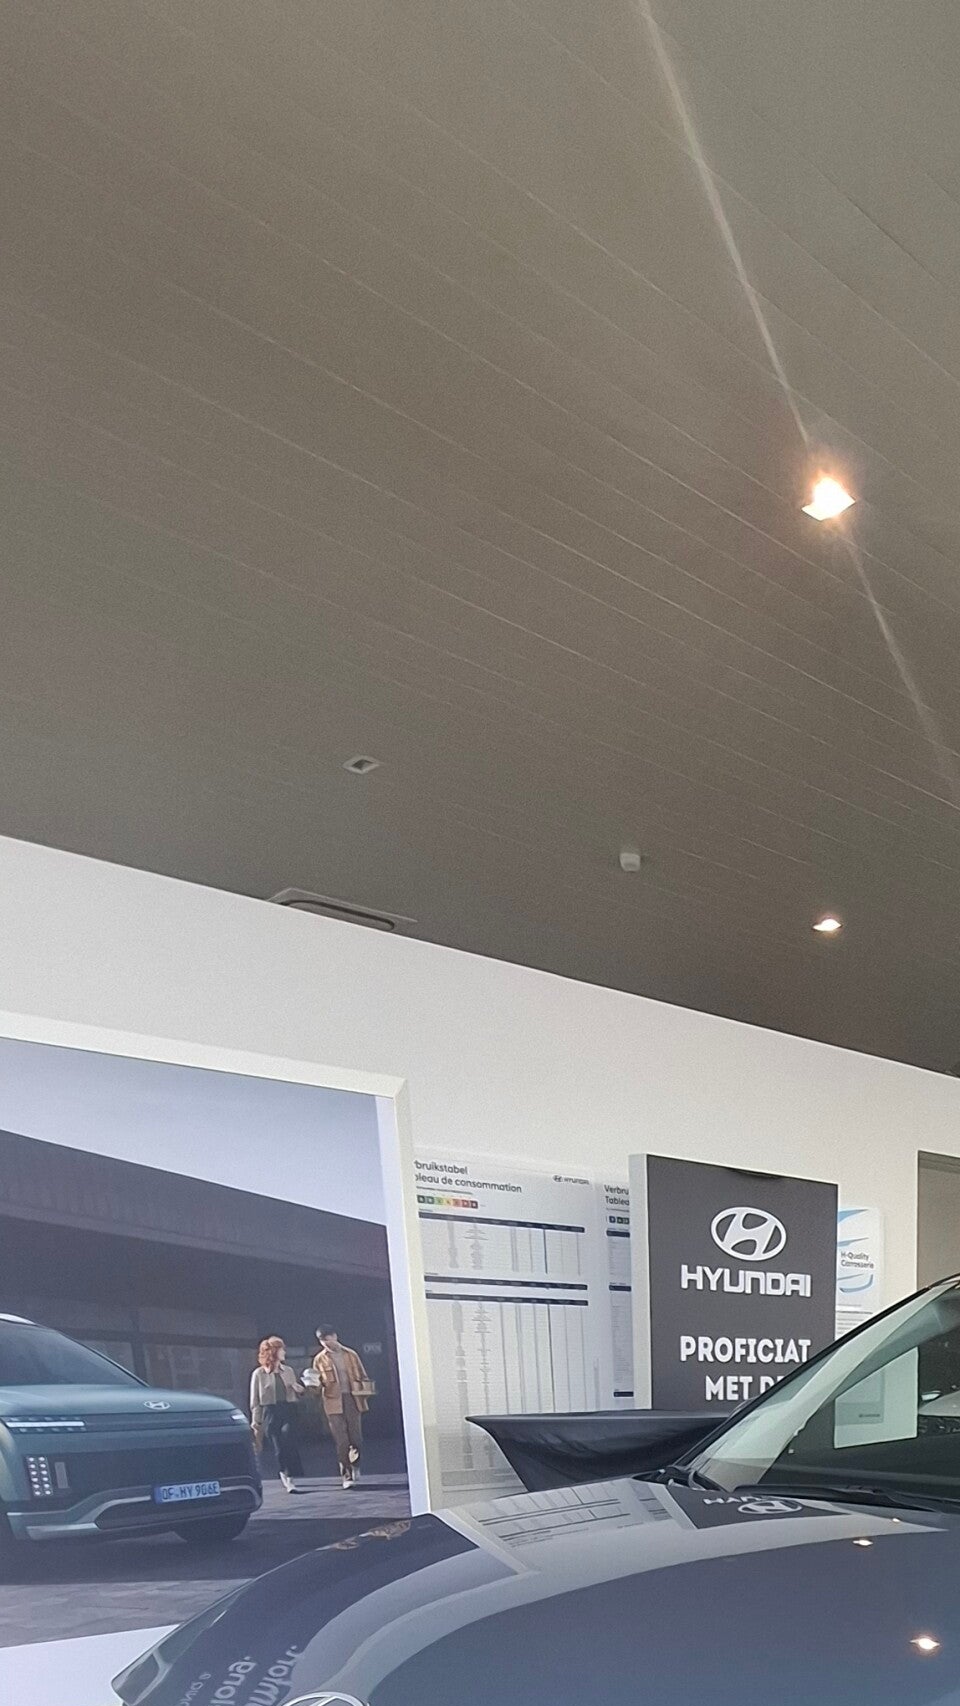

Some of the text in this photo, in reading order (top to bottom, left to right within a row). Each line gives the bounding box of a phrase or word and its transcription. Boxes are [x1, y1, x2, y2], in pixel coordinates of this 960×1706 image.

[441, 1176, 453, 1186] de
[455, 1179, 522, 1193] consommation
[681, 1264, 812, 1297] HYUNDAI
[680, 1335, 811, 1363] PROFICIAT
[705, 1375, 753, 1401] MET
